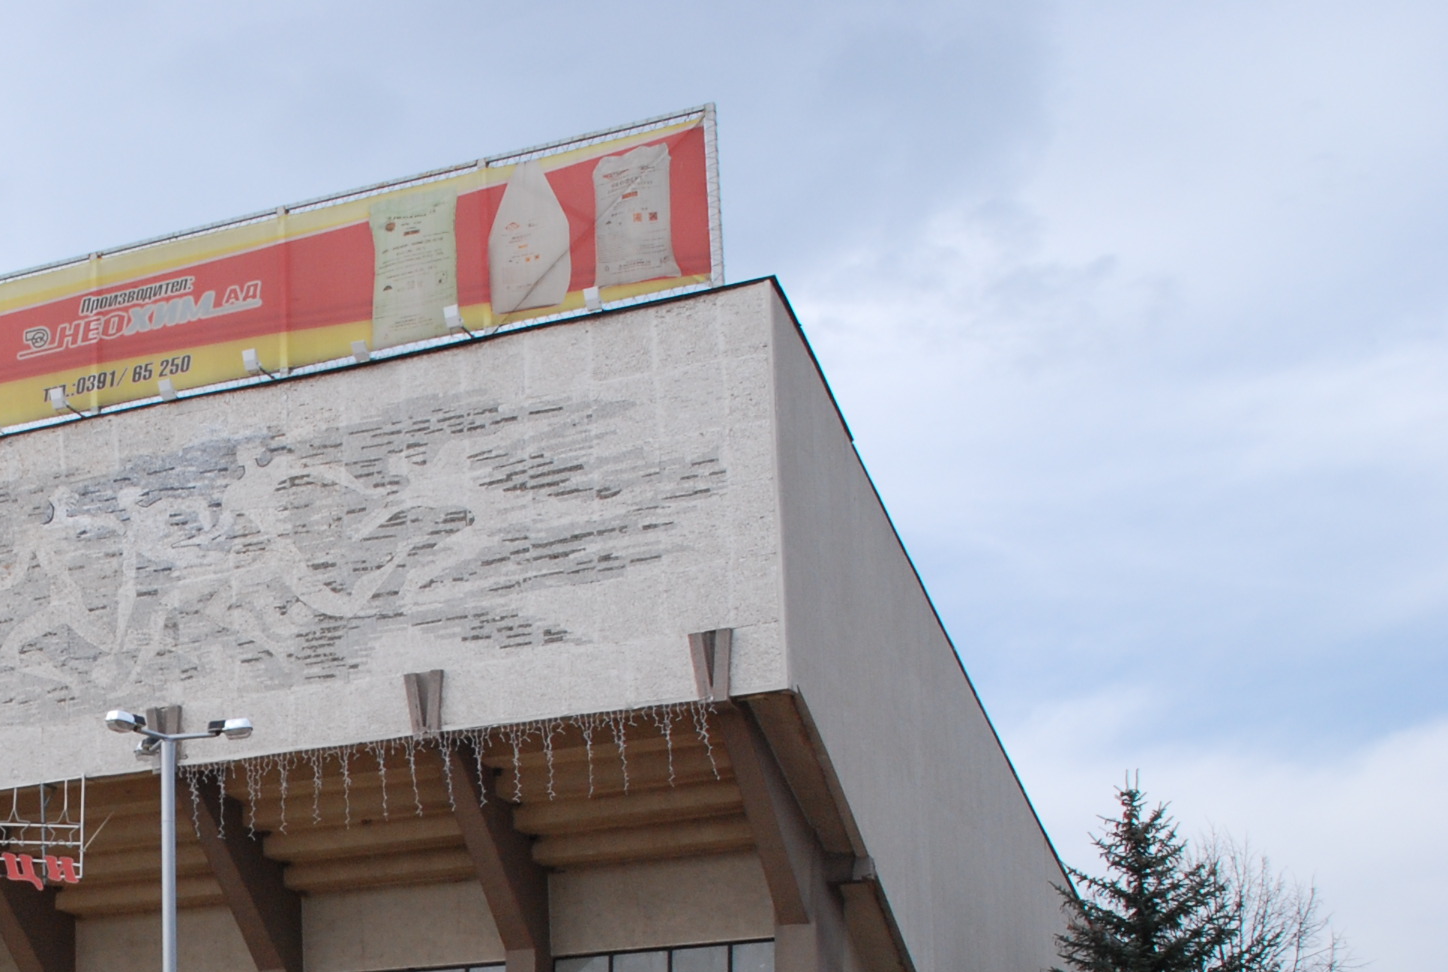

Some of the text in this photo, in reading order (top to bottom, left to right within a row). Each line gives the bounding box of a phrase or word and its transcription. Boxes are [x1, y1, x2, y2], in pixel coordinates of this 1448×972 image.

[55, 280, 262, 348] НЕОХИМ АД
[131, 362, 153, 384] 65
[158, 355, 192, 378] 250
